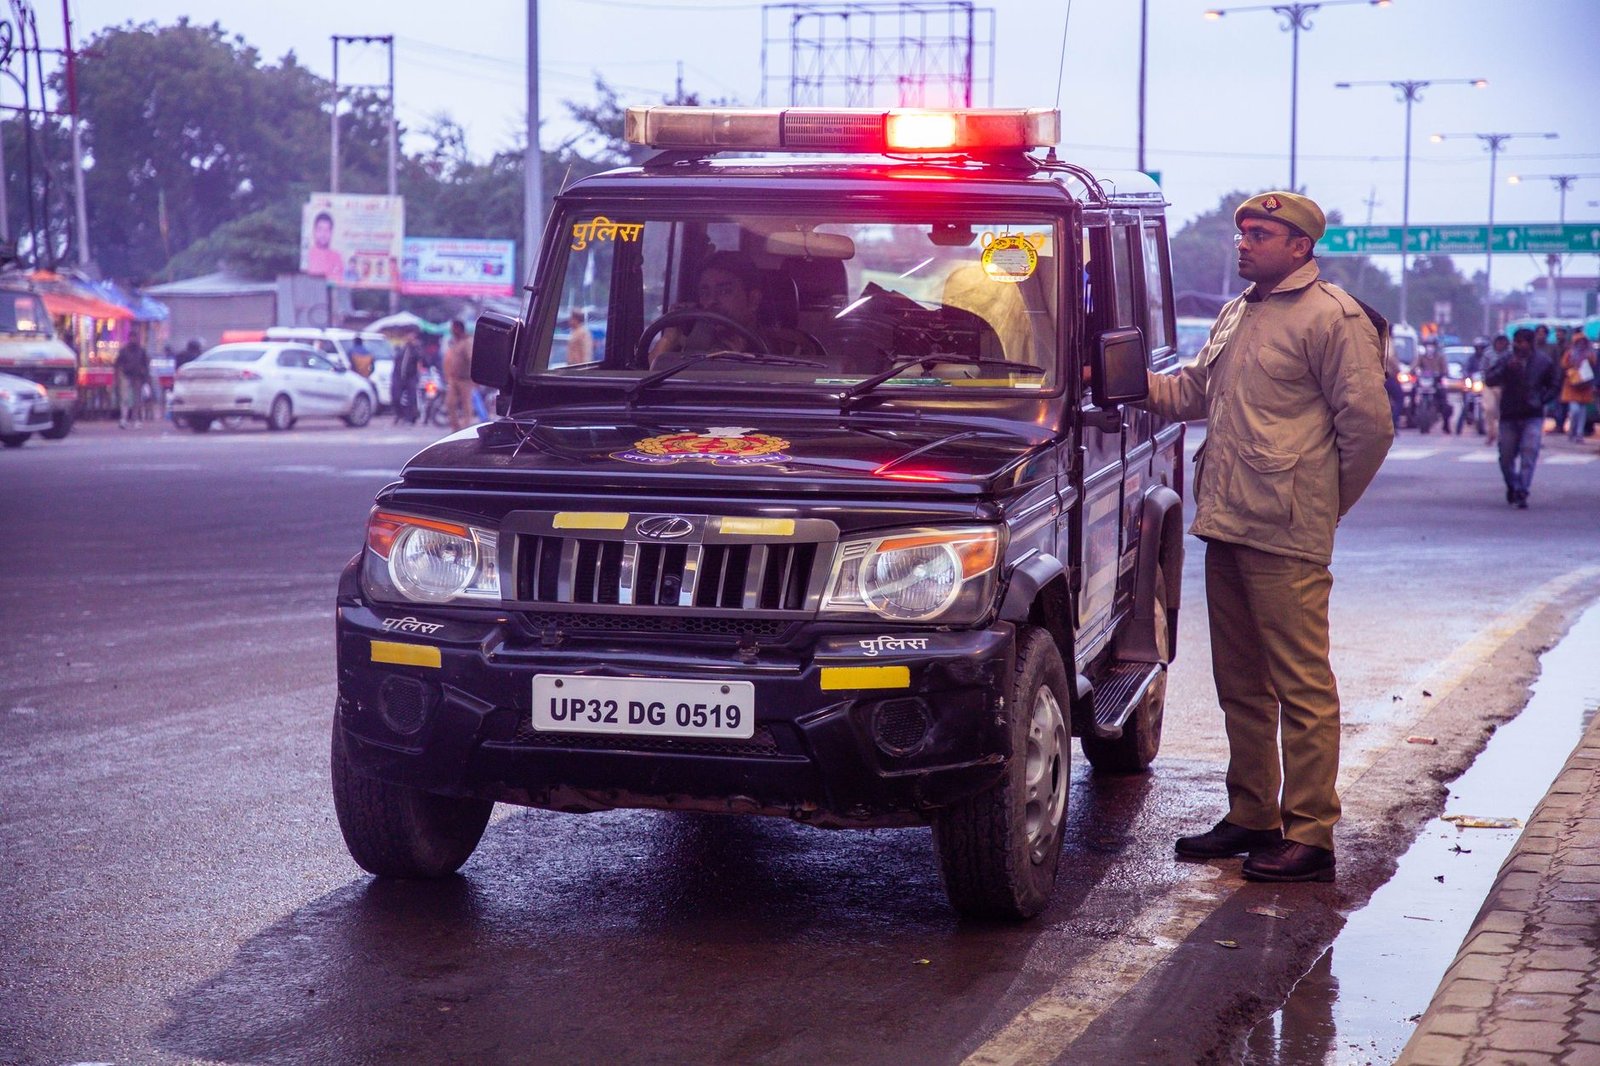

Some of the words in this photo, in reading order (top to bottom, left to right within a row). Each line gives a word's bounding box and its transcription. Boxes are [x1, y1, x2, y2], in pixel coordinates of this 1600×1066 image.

[571, 216, 644, 251] पुलिस
[382, 616, 445, 633] पुलिस
[859, 635, 929, 656] पुलिस
[550, 697, 618, 724] UP32
[628, 701, 666, 725] DG
[675, 703, 741, 729] 0519
